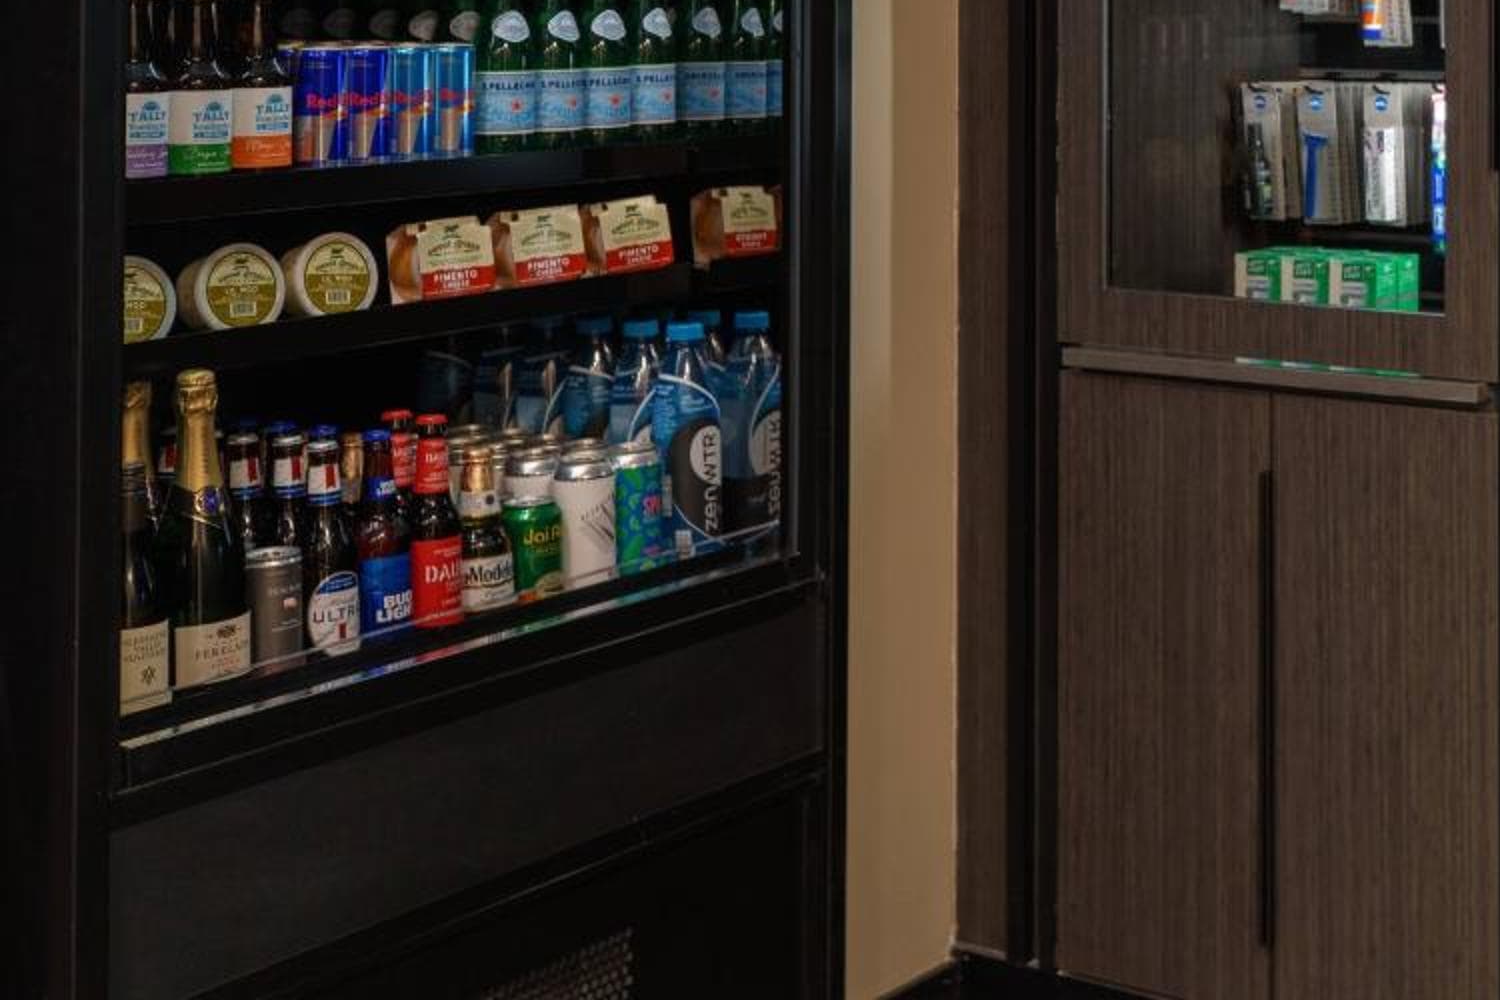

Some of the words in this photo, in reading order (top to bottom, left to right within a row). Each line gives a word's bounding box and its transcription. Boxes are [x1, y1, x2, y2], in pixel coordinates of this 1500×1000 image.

[618, 245, 660, 259] PIMENTO
[527, 257, 571, 271] PIMENTO
[433, 269, 478, 282] PIMENTO
